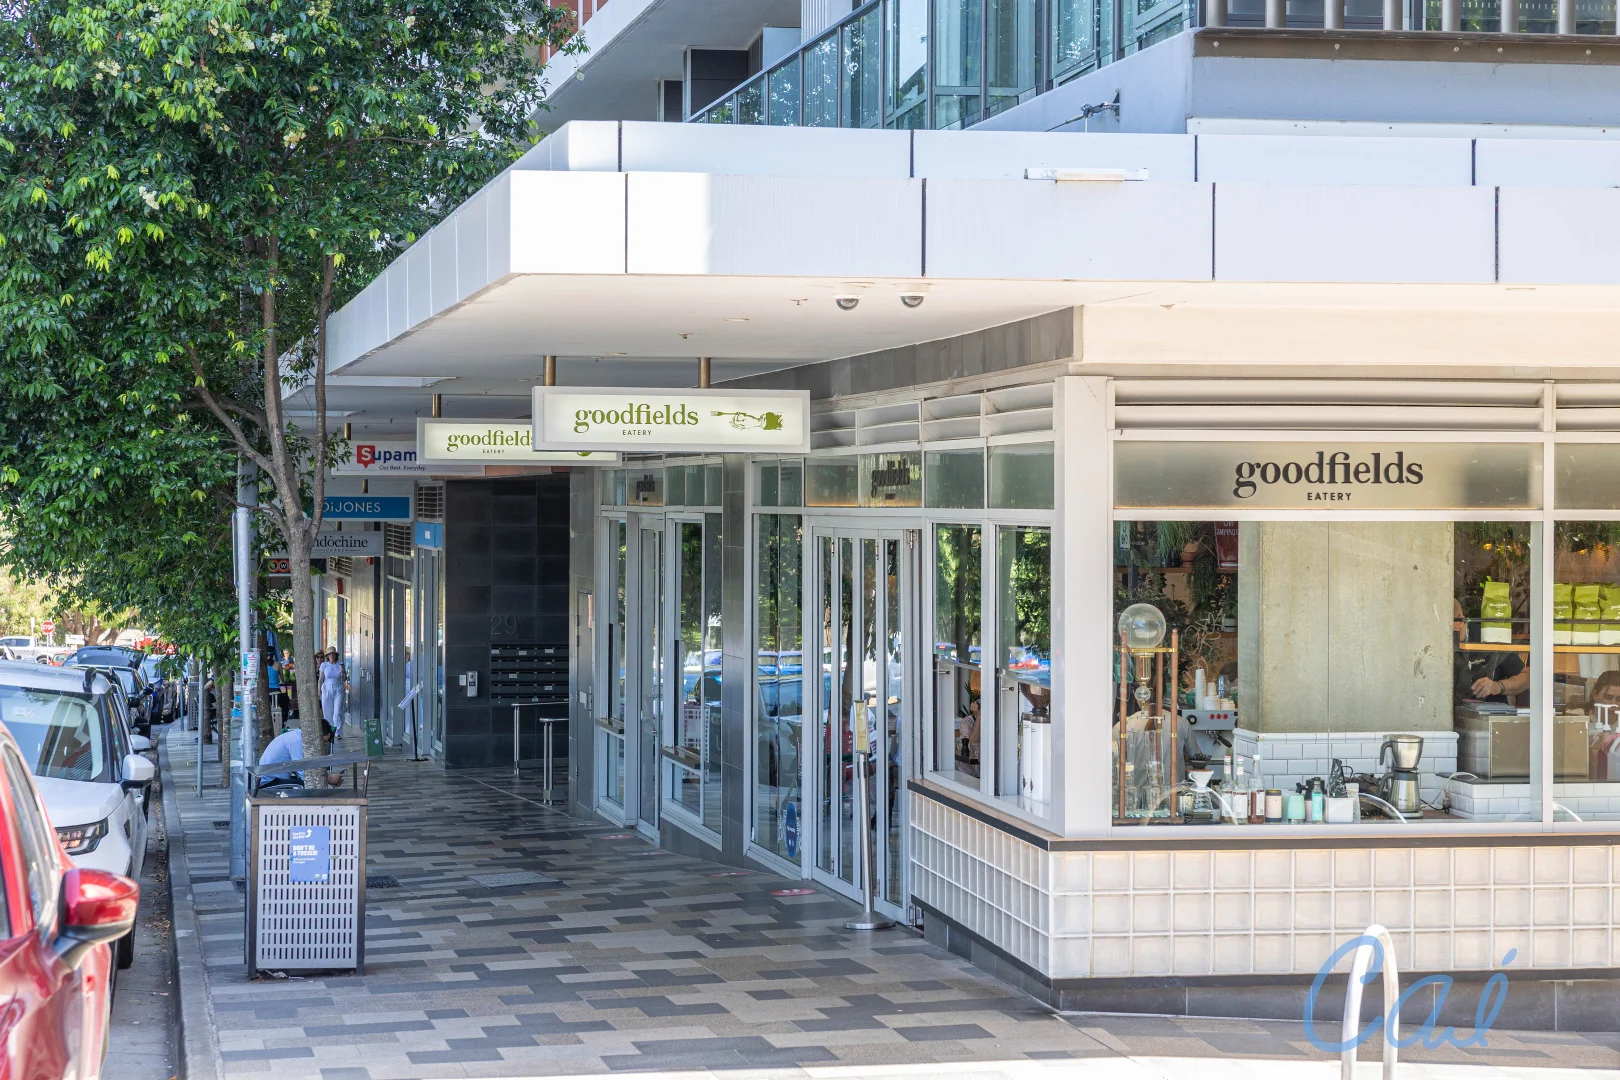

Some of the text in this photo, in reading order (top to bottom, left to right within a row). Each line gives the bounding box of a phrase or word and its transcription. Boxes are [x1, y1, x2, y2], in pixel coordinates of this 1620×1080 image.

[574, 403, 699, 433] goodfields
[447, 430, 533, 452] goodfield
[1232, 451, 1424, 499] goodfields
[1307, 492, 1352, 501] EATERY
[312, 535, 369, 548] ndôchine
[491, 614, 518, 635] 29
